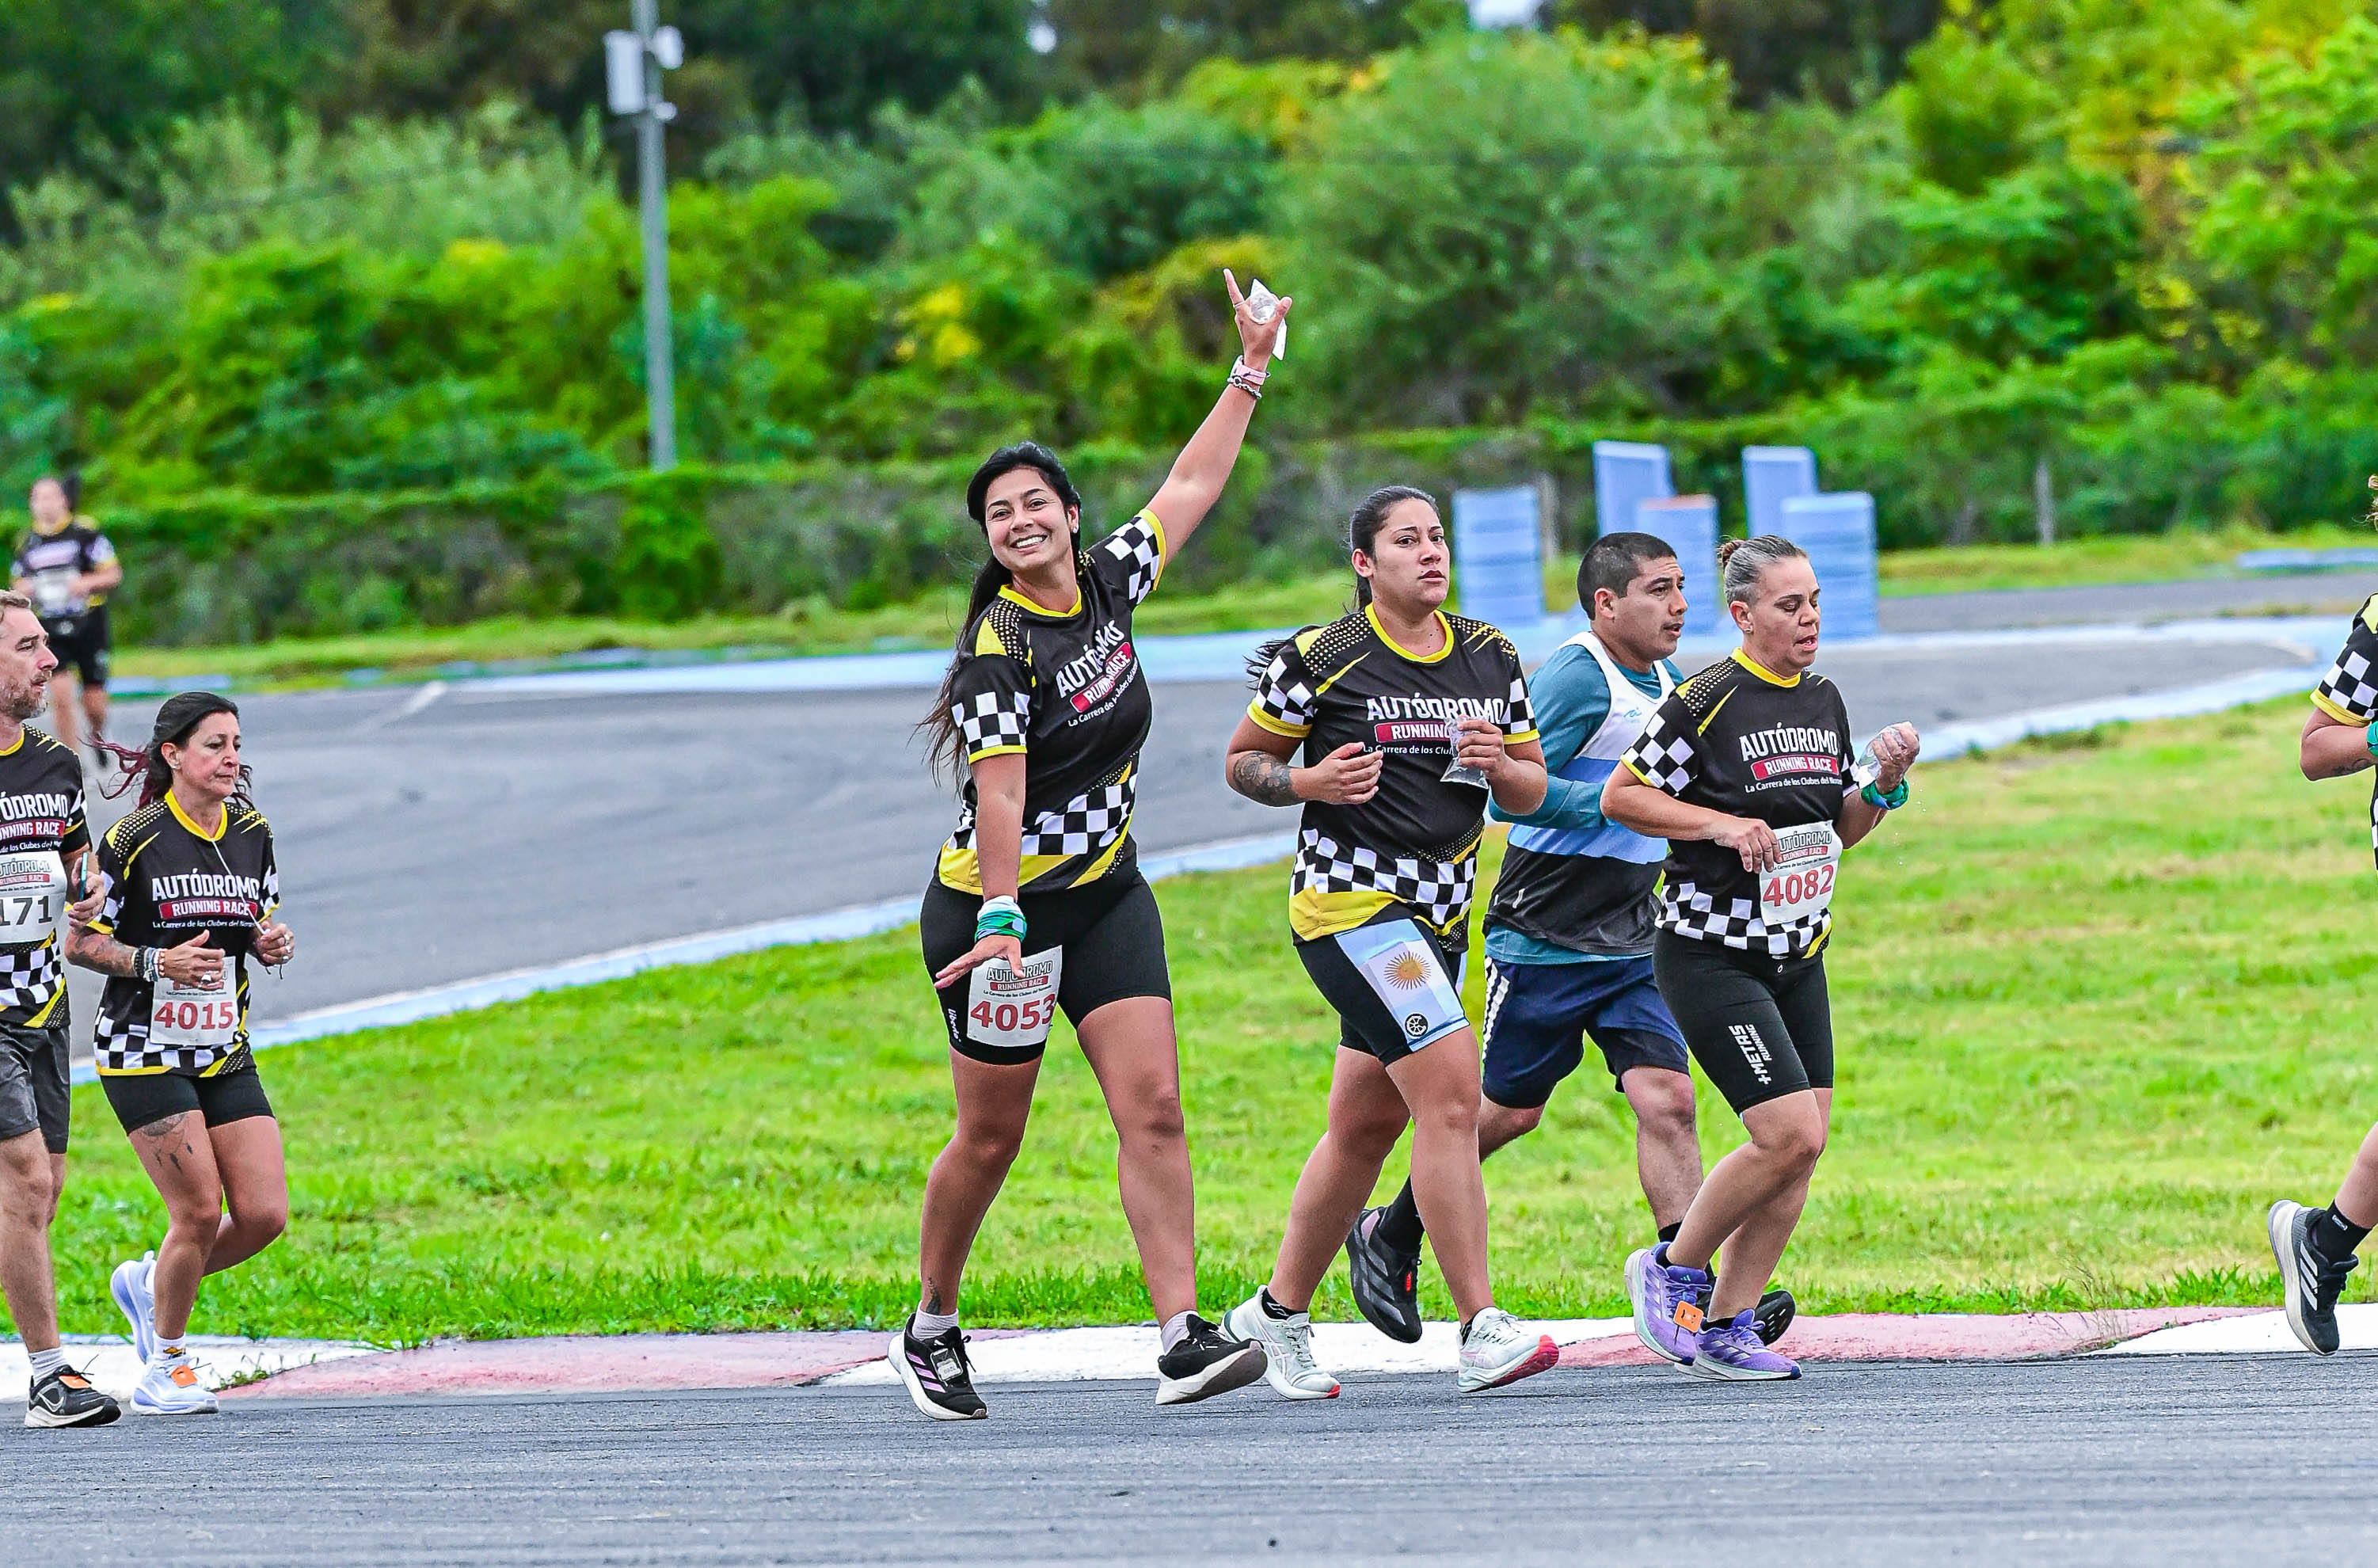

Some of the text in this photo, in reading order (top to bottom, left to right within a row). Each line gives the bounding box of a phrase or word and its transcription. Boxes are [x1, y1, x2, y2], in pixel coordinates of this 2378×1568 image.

[1079, 706, 1105, 722] Carrera
[1104, 702, 1114, 710] de
[1366, 692, 1505, 725] AUTÓDROMO
[1409, 745, 1419, 754] de
[1421, 745, 1433, 754] los
[1739, 721, 1838, 762] AUTÓDROMO
[1764, 757, 1832, 775] RUNNING RACE
[1756, 780, 1783, 791] Carrera
[0, 791, 68, 820] ÓDROMO
[36, 821, 60, 835] RACE
[1779, 831, 1832, 851] UTÓDROMO
[152, 868, 260, 901] AUTÓDROMO
[1763, 865, 1833, 907] 4082
[172, 900, 249, 916] RUNNING RACE
[987, 961, 1053, 981] AUTROMO
[997, 980, 1027, 991] RUNNING
[1029, 977, 1044, 987] RACE
[154, 1001, 234, 1029] 4015
[970, 993, 1056, 1031] 4053
[1745, 1024, 1772, 1061] RUNNING
